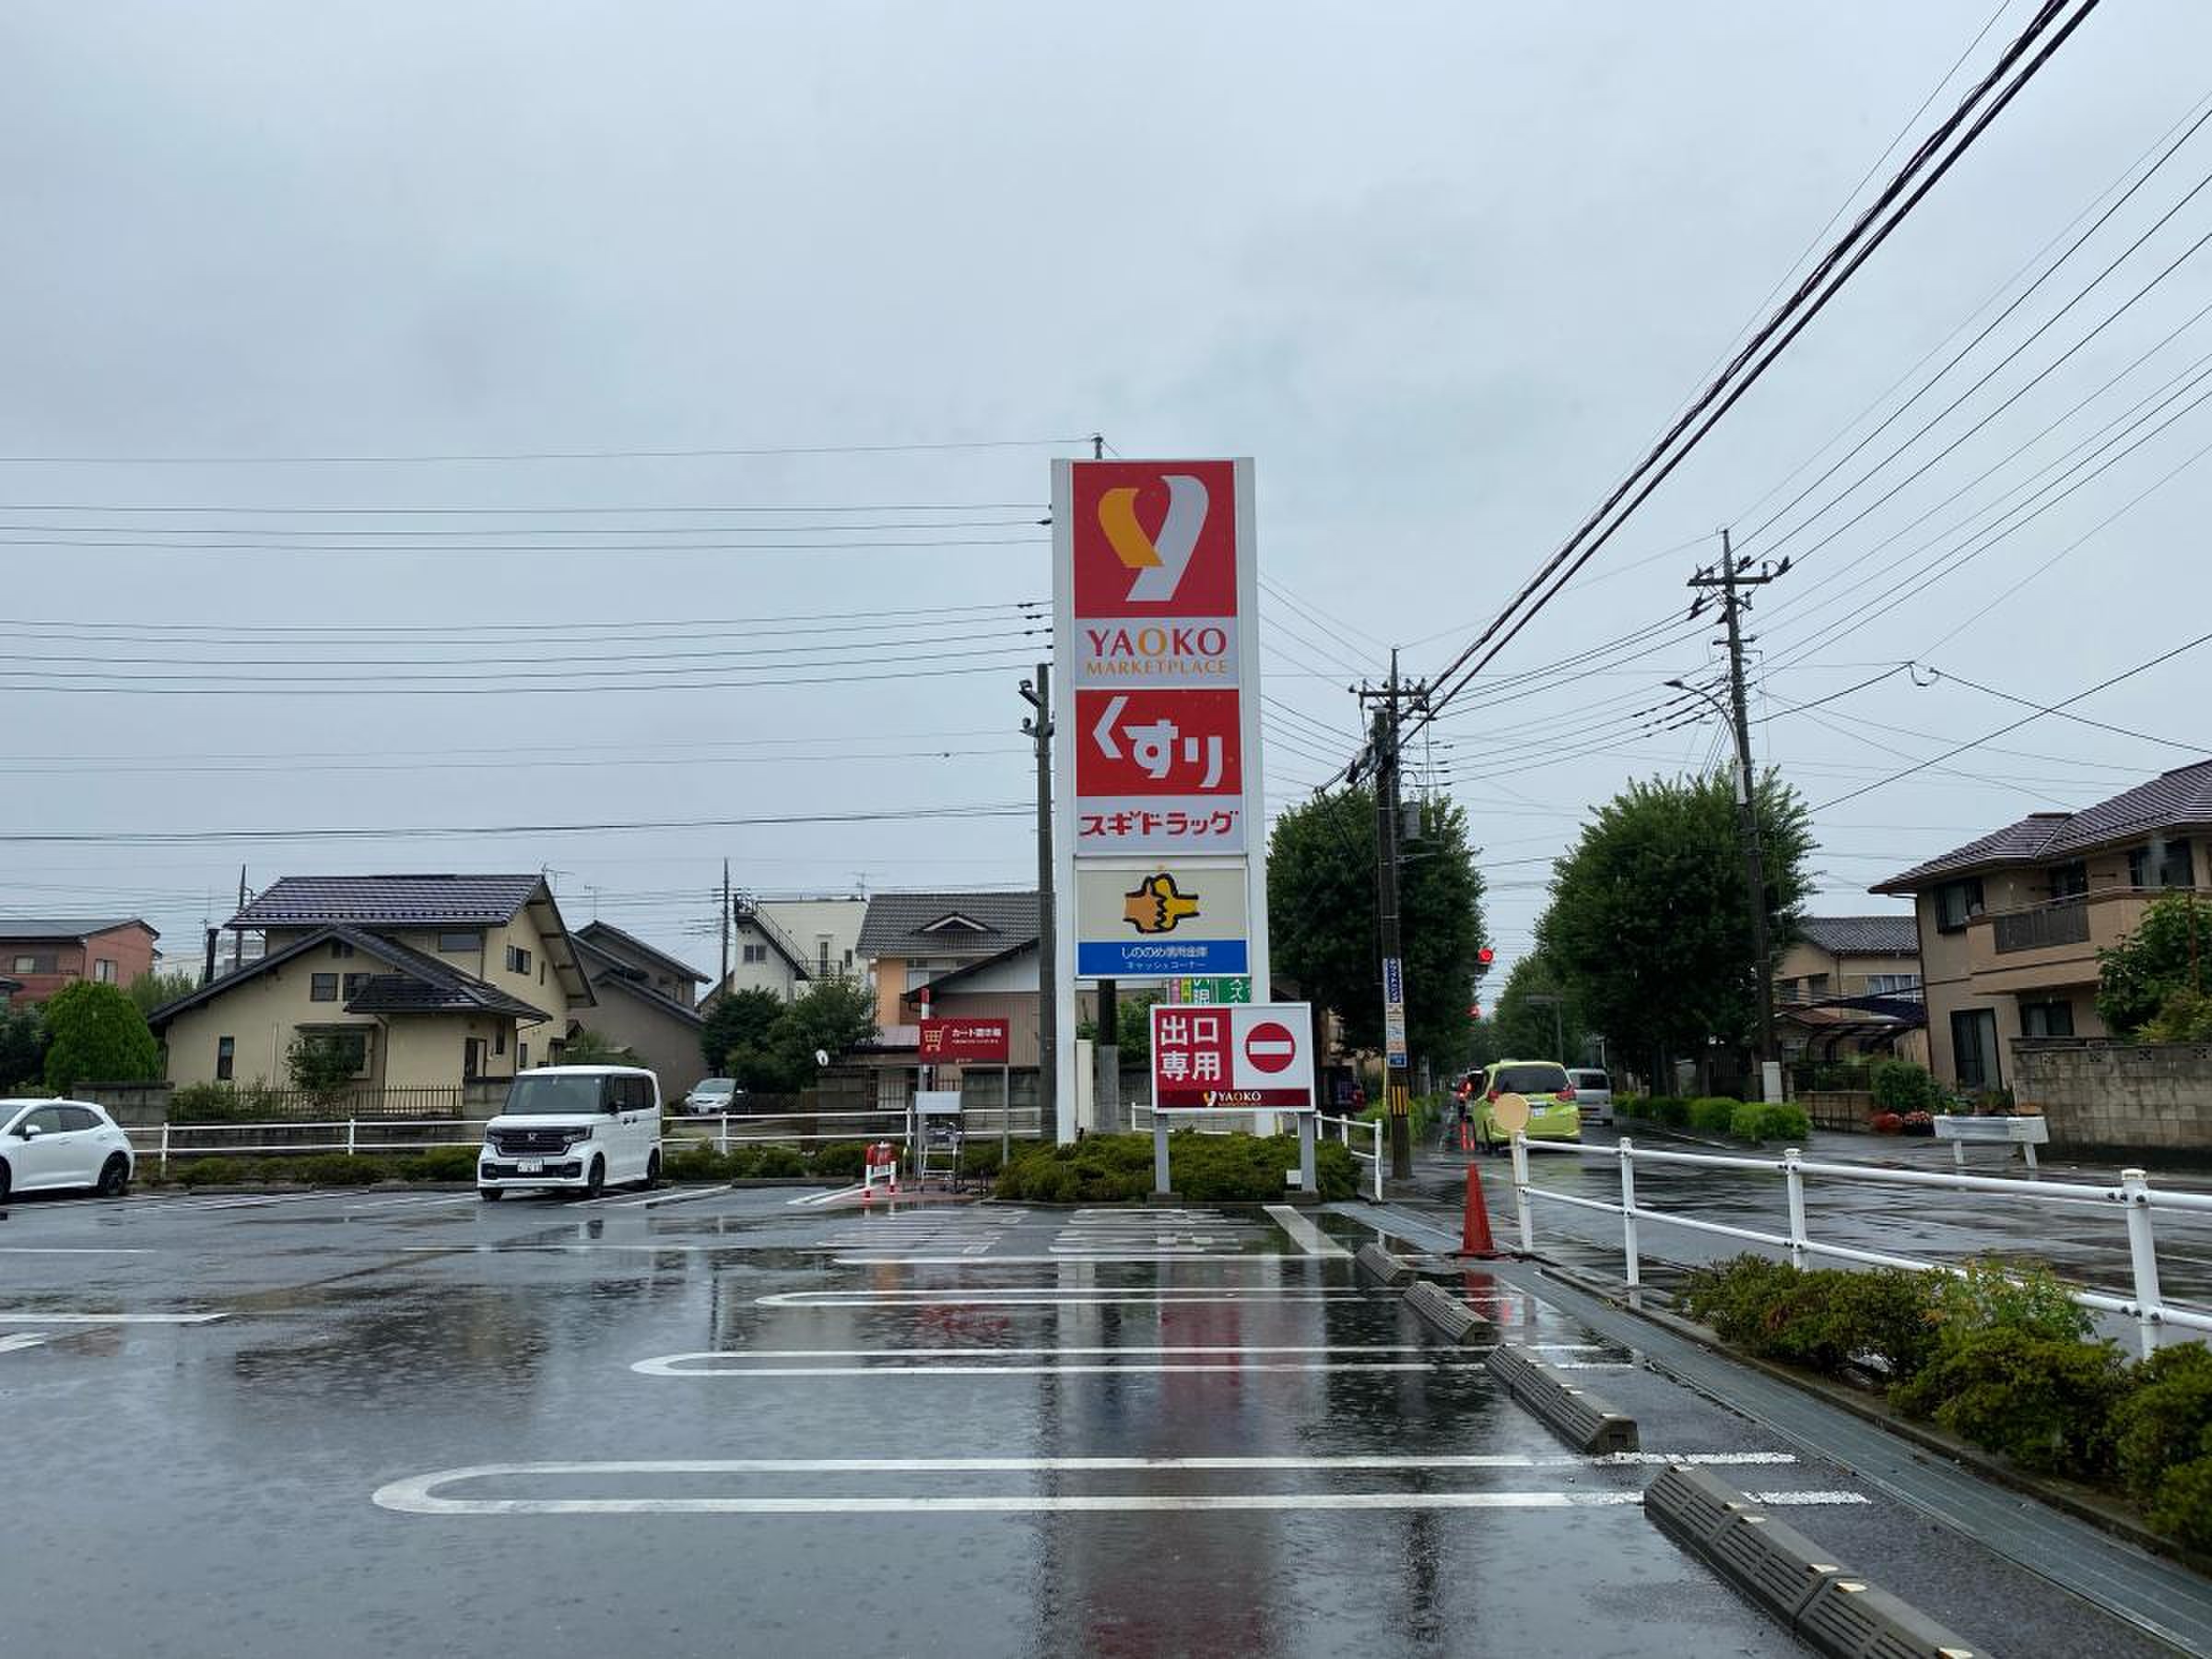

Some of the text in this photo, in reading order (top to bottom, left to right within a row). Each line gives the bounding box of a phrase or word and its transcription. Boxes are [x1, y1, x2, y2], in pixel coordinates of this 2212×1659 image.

[1086, 628, 1227, 657] YAOKO
[1085, 658, 1227, 676] MARKETPLACE
[1092, 695, 1224, 788] くすり
[1078, 809, 1240, 838] スギドラッグ
[1160, 1016, 1218, 1046] 出口
[1159, 1051, 1221, 1082] 専用
[1218, 1090, 1262, 1102] YAOKO
